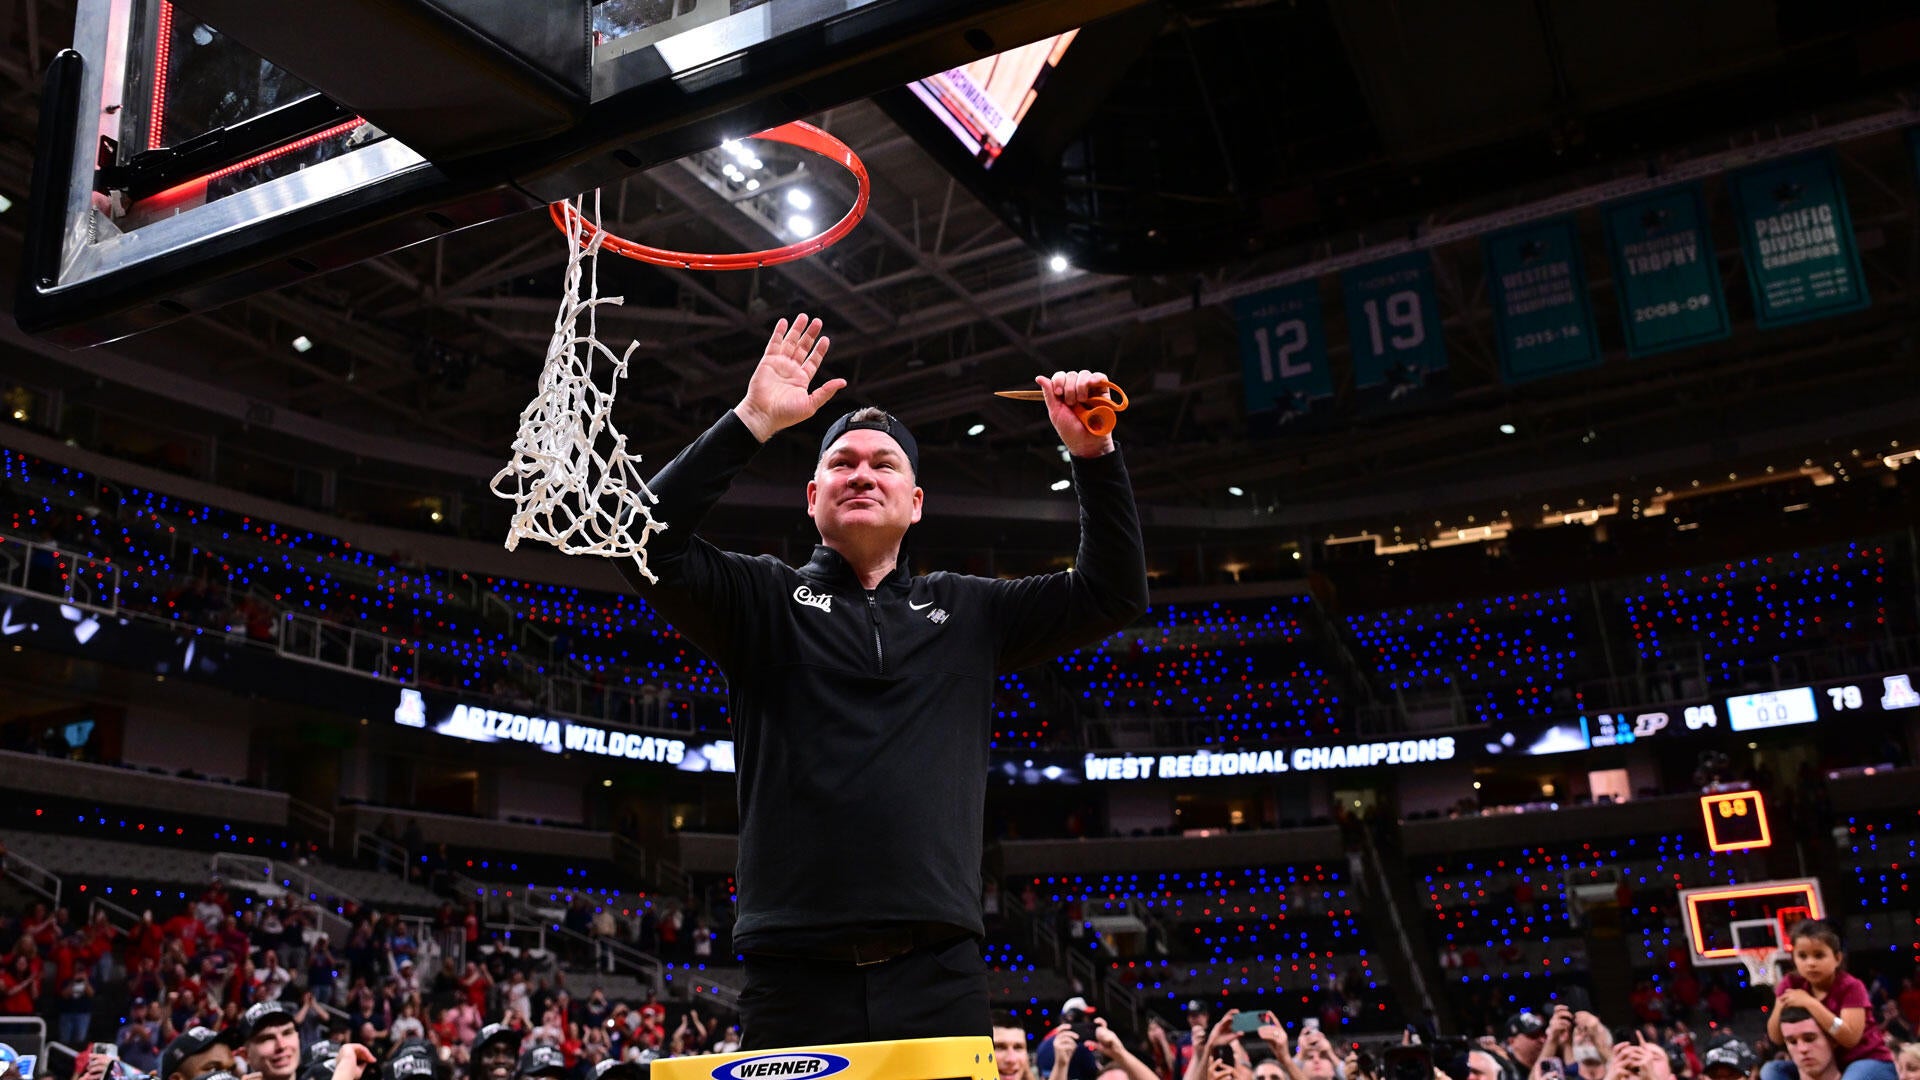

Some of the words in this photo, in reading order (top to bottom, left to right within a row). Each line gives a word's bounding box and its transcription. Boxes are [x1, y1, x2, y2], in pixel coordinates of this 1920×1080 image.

[1754, 203, 1833, 237] PACIFIC
[1759, 224, 1837, 256] DIVISION
[1627, 244, 1698, 276] TROPHY
[1762, 242, 1841, 272] CHAMPIONS
[1364, 289, 1426, 357] 19
[1634, 294, 1712, 323] 2008-09
[1254, 318, 1314, 384] 12
[793, 586, 833, 613] Cats
[1827, 686, 1862, 711] 79
[1685, 705, 1717, 730] 64
[449, 704, 561, 746] ARIZONA
[565, 724, 685, 765] WILDCATS
[1085, 757, 1155, 780] WEST
[1158, 751, 1289, 778] REGIONAL
[1292, 737, 1455, 771] CHAMPIONS
[740, 1060, 820, 1078] WERNER
